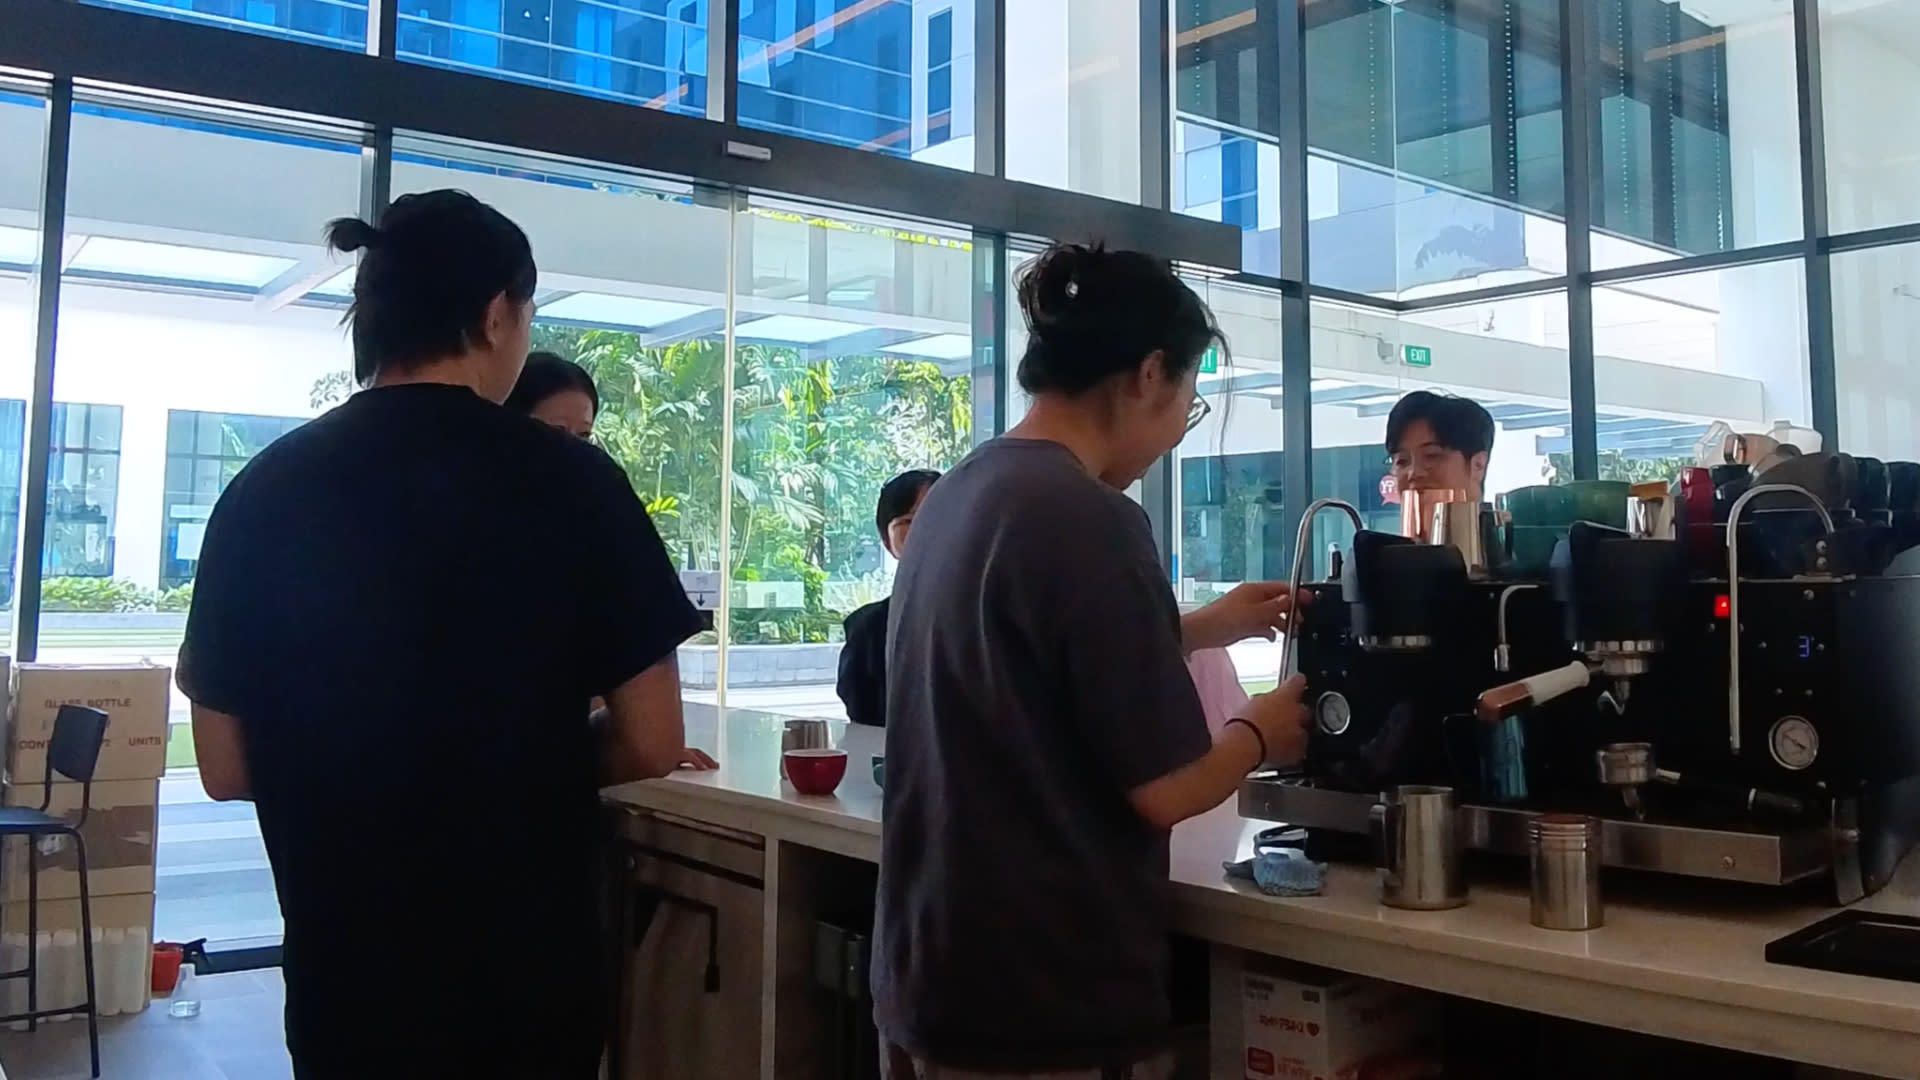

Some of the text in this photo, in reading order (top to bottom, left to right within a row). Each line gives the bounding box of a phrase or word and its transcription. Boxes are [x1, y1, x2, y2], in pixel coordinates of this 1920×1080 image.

[1411, 349, 1426, 361] EXIT
[1799, 635, 1810, 658] 3
[87, 698, 132, 708] BOTTLE
[128, 736, 162, 746] UNITS
